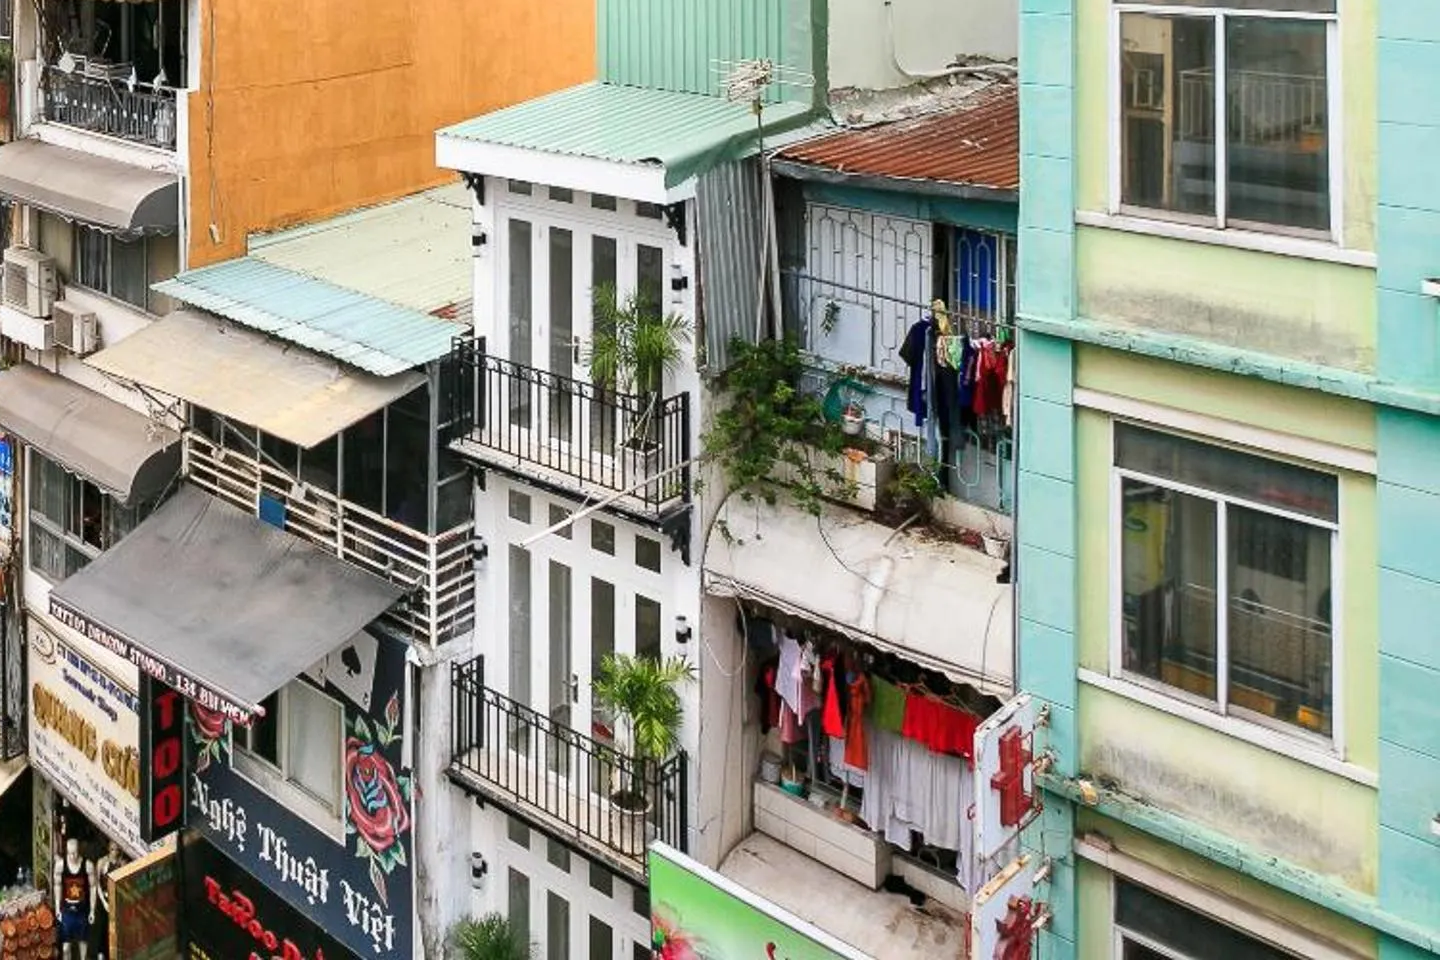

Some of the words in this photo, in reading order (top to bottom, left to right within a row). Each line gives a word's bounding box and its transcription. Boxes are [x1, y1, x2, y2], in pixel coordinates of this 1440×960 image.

[88, 622, 127, 659] DRAGON
[129, 647, 166, 681] STUDIO
[191, 772, 247, 852] Nghệ
[257, 823, 329, 905] Thuật
[339, 879, 396, 954] Việt
